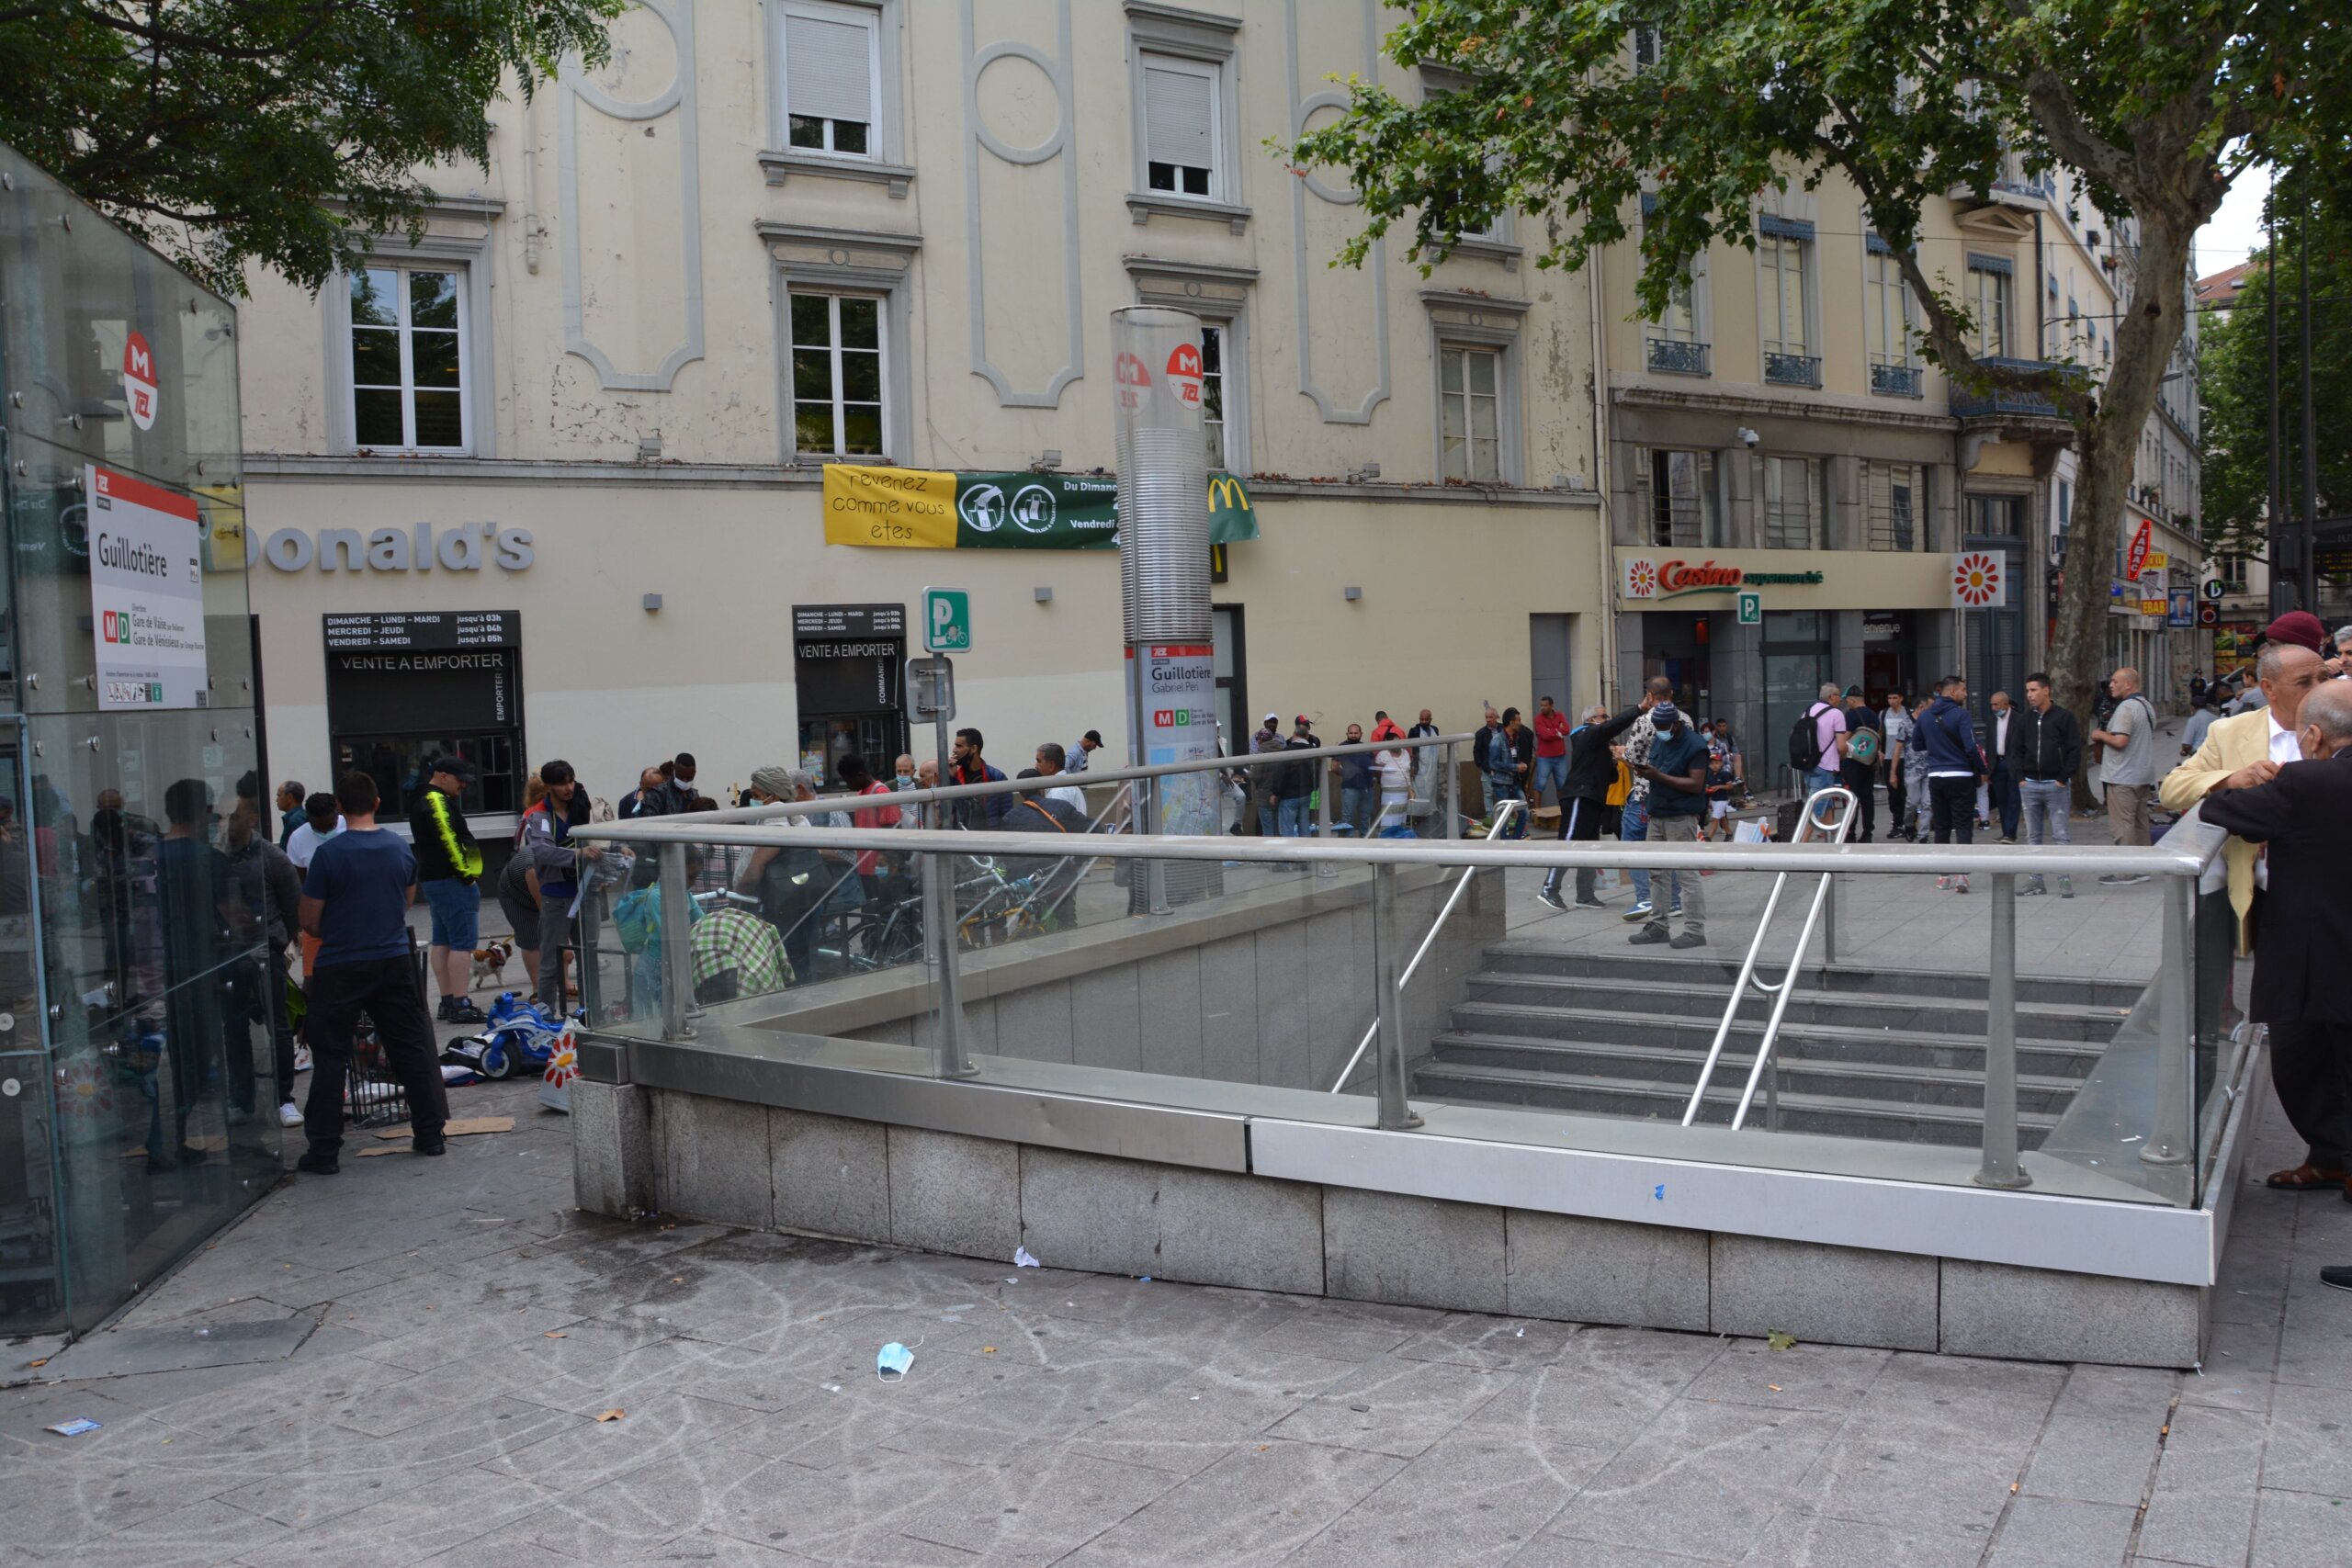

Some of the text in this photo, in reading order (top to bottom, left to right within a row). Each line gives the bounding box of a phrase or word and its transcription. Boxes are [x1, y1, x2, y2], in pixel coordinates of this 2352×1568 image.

[131, 344, 149, 378] M
[1179, 353, 1198, 374] M
[850, 473, 928, 492] revenez
[1064, 481, 1118, 491] Du Dimanc
[833, 497, 944, 515] comme vous
[871, 519, 912, 541] etes
[1070, 519, 1114, 529] Vendredi
[98, 532, 167, 578] Guillotière
[2131, 528, 2148, 571] TABAC
[1658, 560, 1742, 592] Casino
[1746, 597, 1755, 617] P
[2143, 601, 2165, 614] EBAB
[132, 614, 145, 628] Gare
[146, 617, 153, 628] de
[327, 617, 371, 626] DIMANCHE
[413, 615, 440, 624] MARDI
[457, 615, 485, 625] jusqu'à
[933, 598, 953, 636] P
[106, 615, 129, 639] M D
[328, 627, 371, 636] MERCREDI
[379, 626, 404, 635] JEUDI
[458, 626, 485, 635] jusqu'à
[1863, 623, 1900, 634] envenue
[133, 632, 146, 646] Gare
[147, 636, 153, 647] de
[328, 635, 503, 646] VENDREDI SAMEDI jusqu'à 05h
[799, 643, 895, 658] VENTE A EMPORTER
[341, 654, 503, 670] VENTE A EMPORTER
[1152, 665, 1211, 681] Guillotière
[1152, 682, 1199, 693] Gabriel Péri
[496, 672, 504, 721] EMPORTER
[1159, 712, 1187, 724] M D
